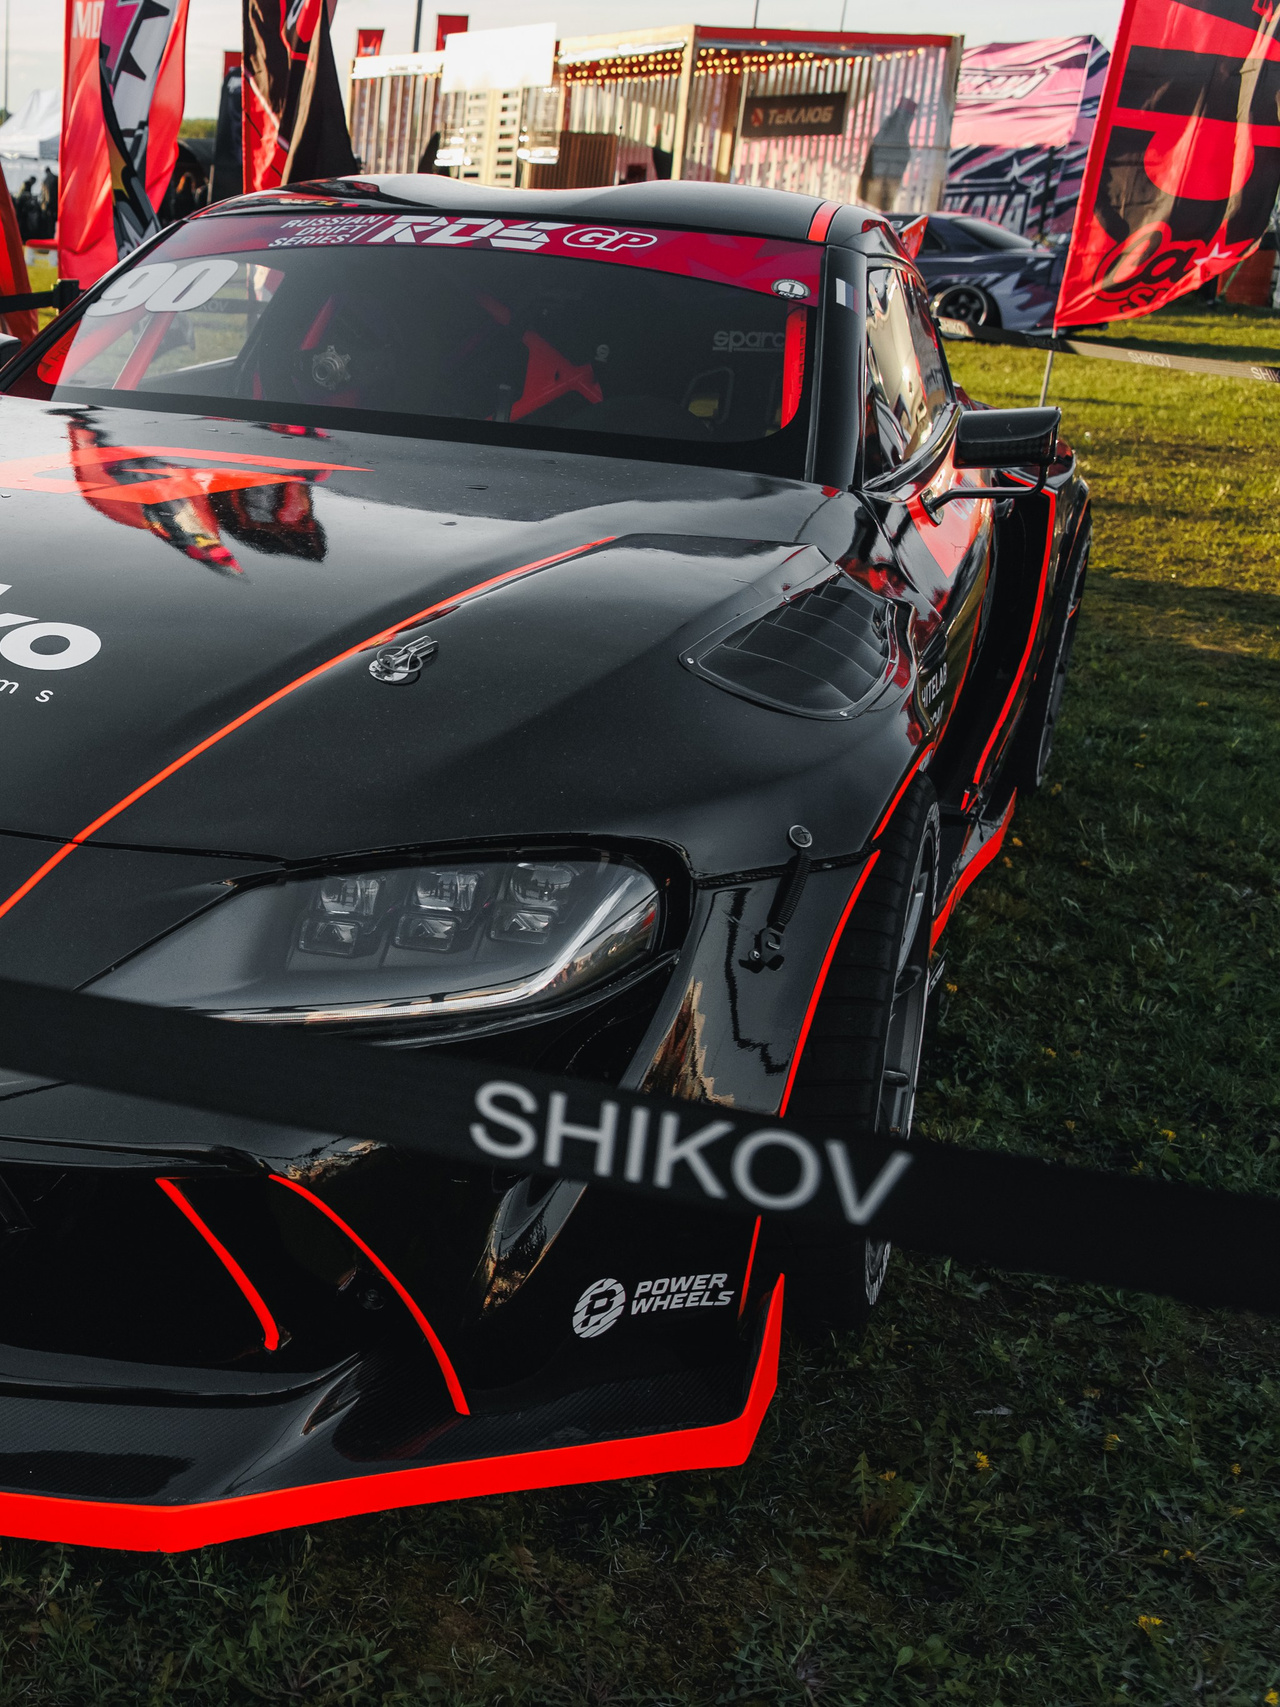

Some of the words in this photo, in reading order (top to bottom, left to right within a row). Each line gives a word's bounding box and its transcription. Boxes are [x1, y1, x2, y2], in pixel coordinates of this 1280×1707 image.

[282, 215, 379, 229] RUSSIAN
[295, 224, 370, 237] DRIFT
[367, 215, 576, 251] RDS
[268, 234, 355, 248] SERIES
[562, 228, 658, 252] GP
[86, 259, 238, 317] 90
[713, 329, 785, 352] sparc
[1128, 351, 1171, 368] SHIKOV
[1250, 366, 1280, 383] SHIK
[469, 1079, 913, 1226] SHIKOV
[634, 1273, 728, 1298] POWER
[630, 1290, 735, 1316] WHEELS
